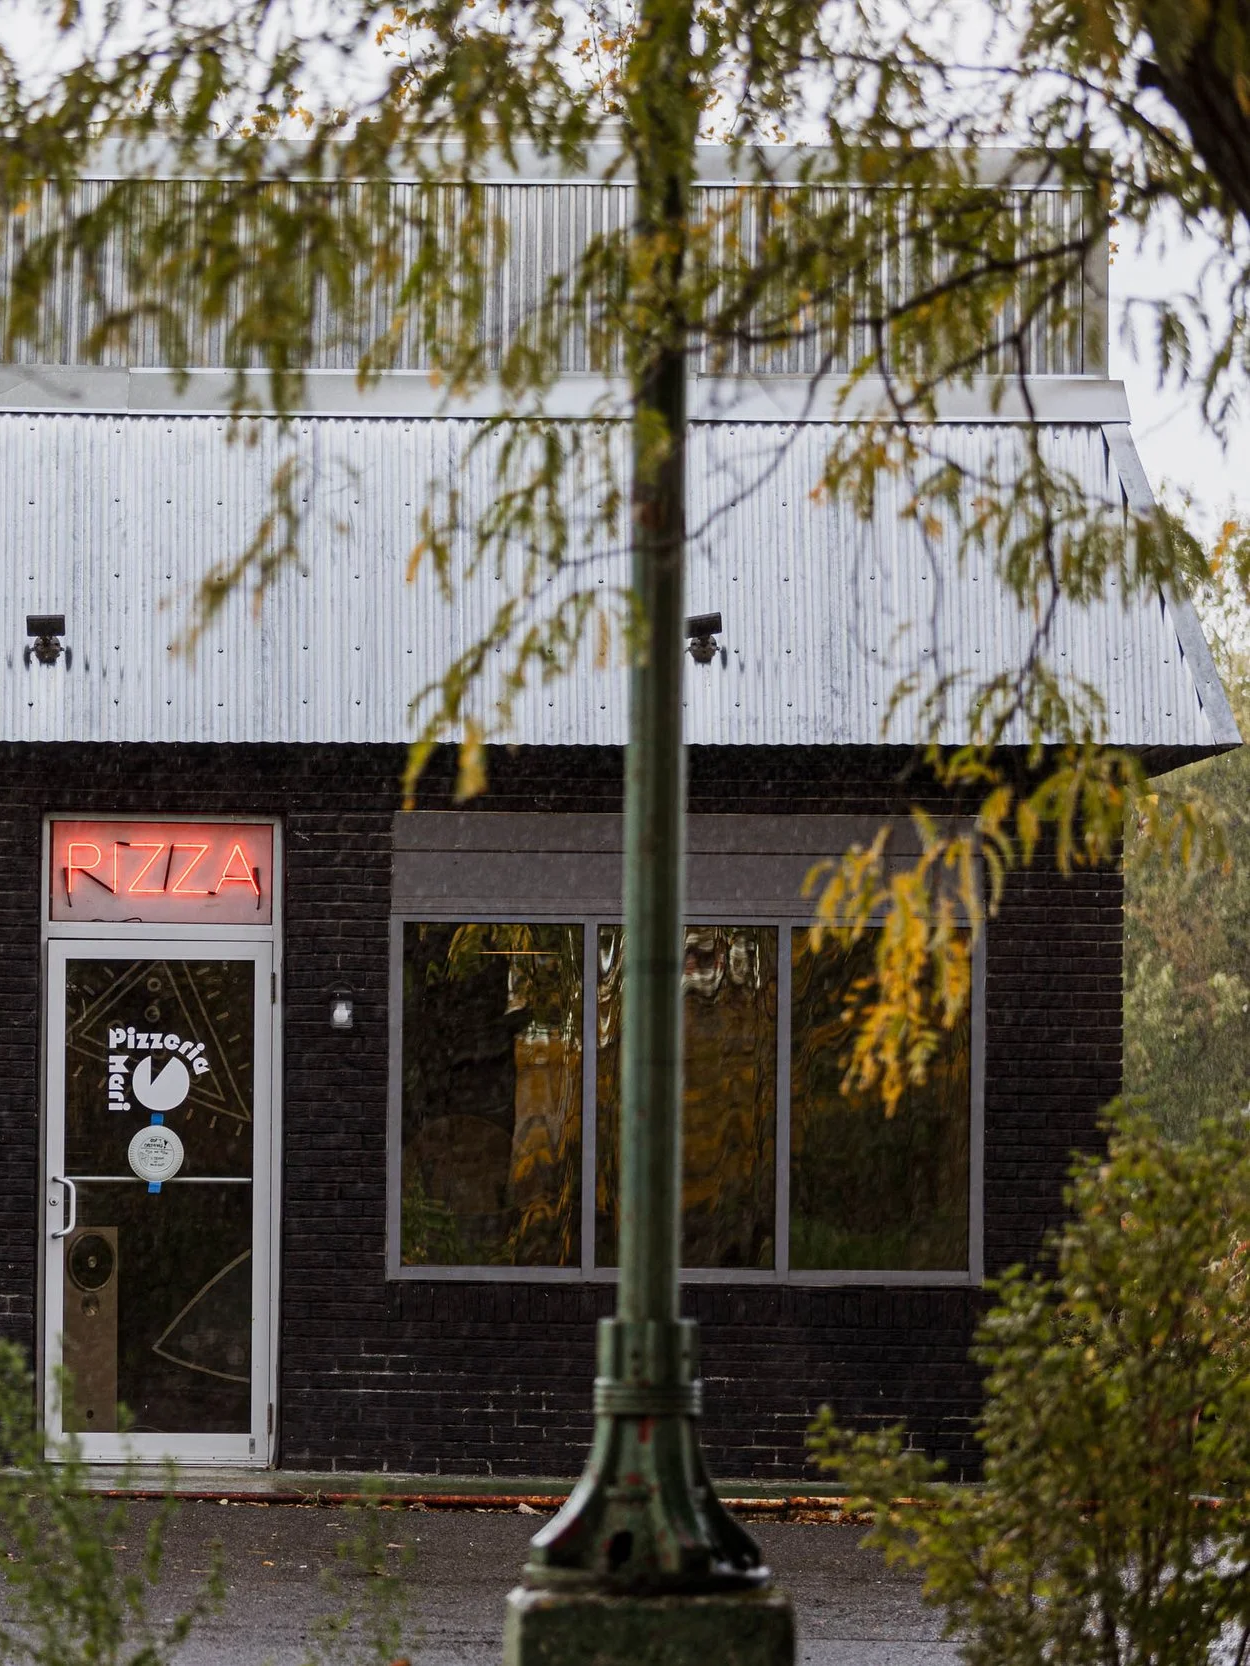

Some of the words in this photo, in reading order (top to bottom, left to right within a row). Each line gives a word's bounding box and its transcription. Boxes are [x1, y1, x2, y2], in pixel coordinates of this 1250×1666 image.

[67, 841, 261, 897] PIZZA
[108, 1026, 210, 1076] Pizzeria
[108, 1055, 131, 1111] Mari
